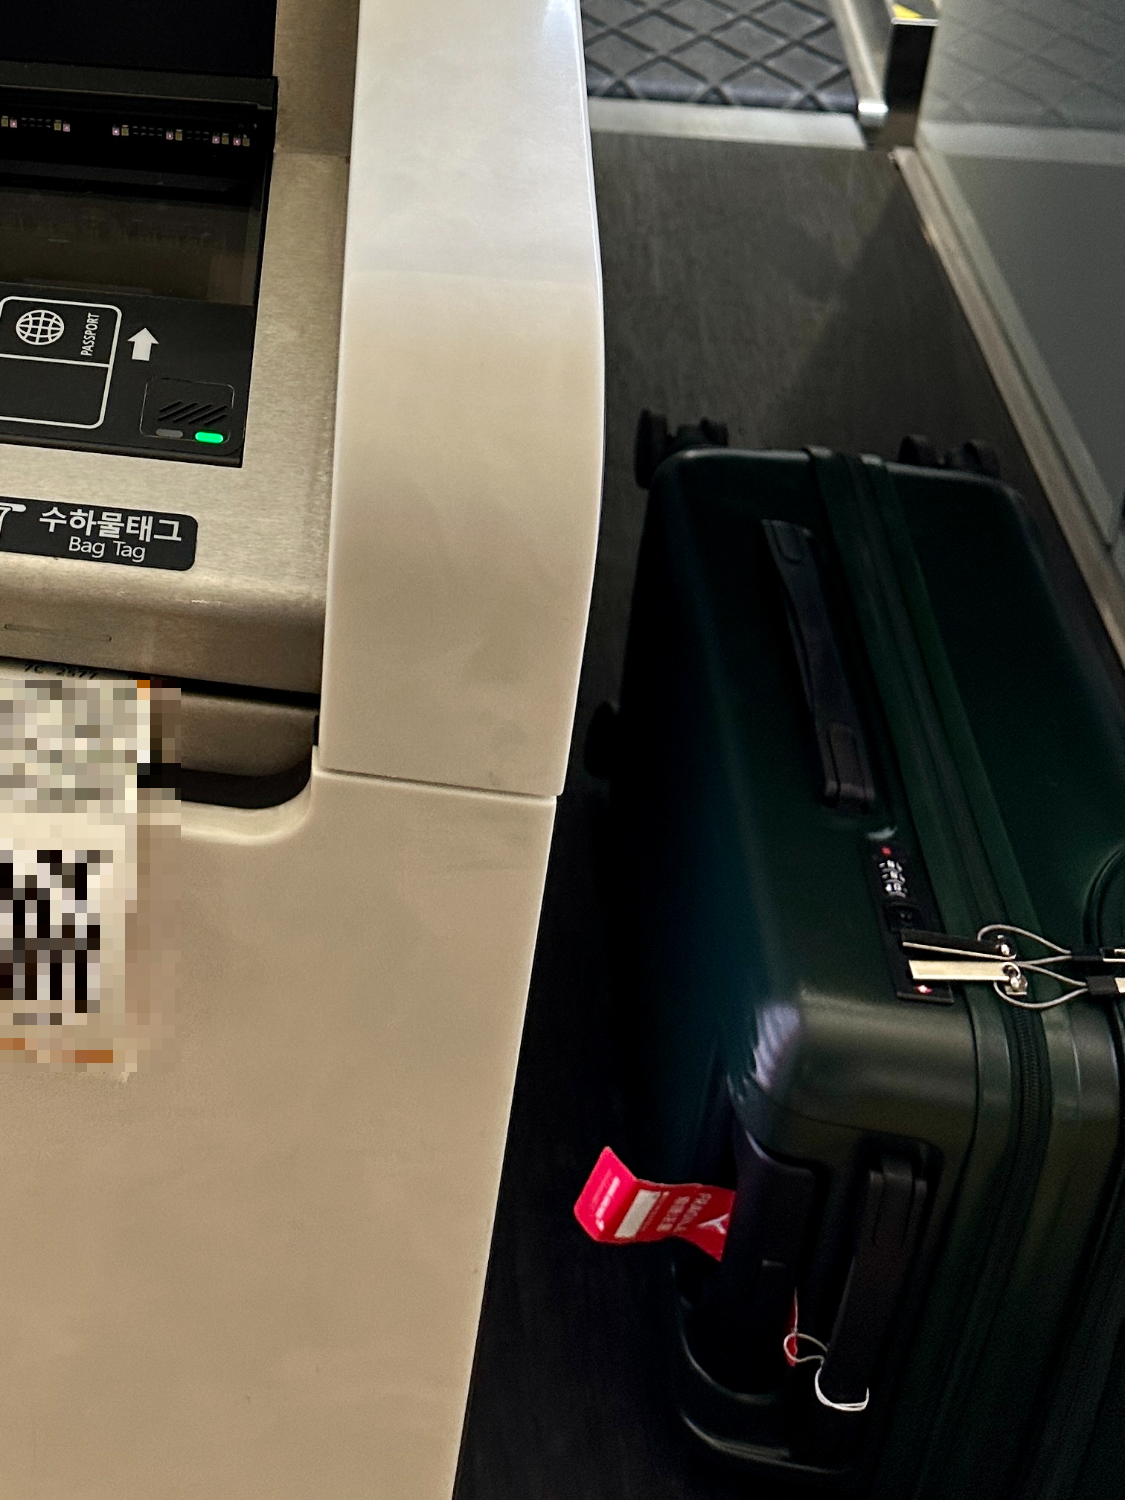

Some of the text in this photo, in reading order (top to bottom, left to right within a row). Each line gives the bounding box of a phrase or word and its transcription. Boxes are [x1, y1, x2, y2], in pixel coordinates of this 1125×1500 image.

[80, 312, 100, 357] PASSPORT
[38, 506, 183, 543] 수하물태그
[68, 536, 146, 563] Bag Tag
